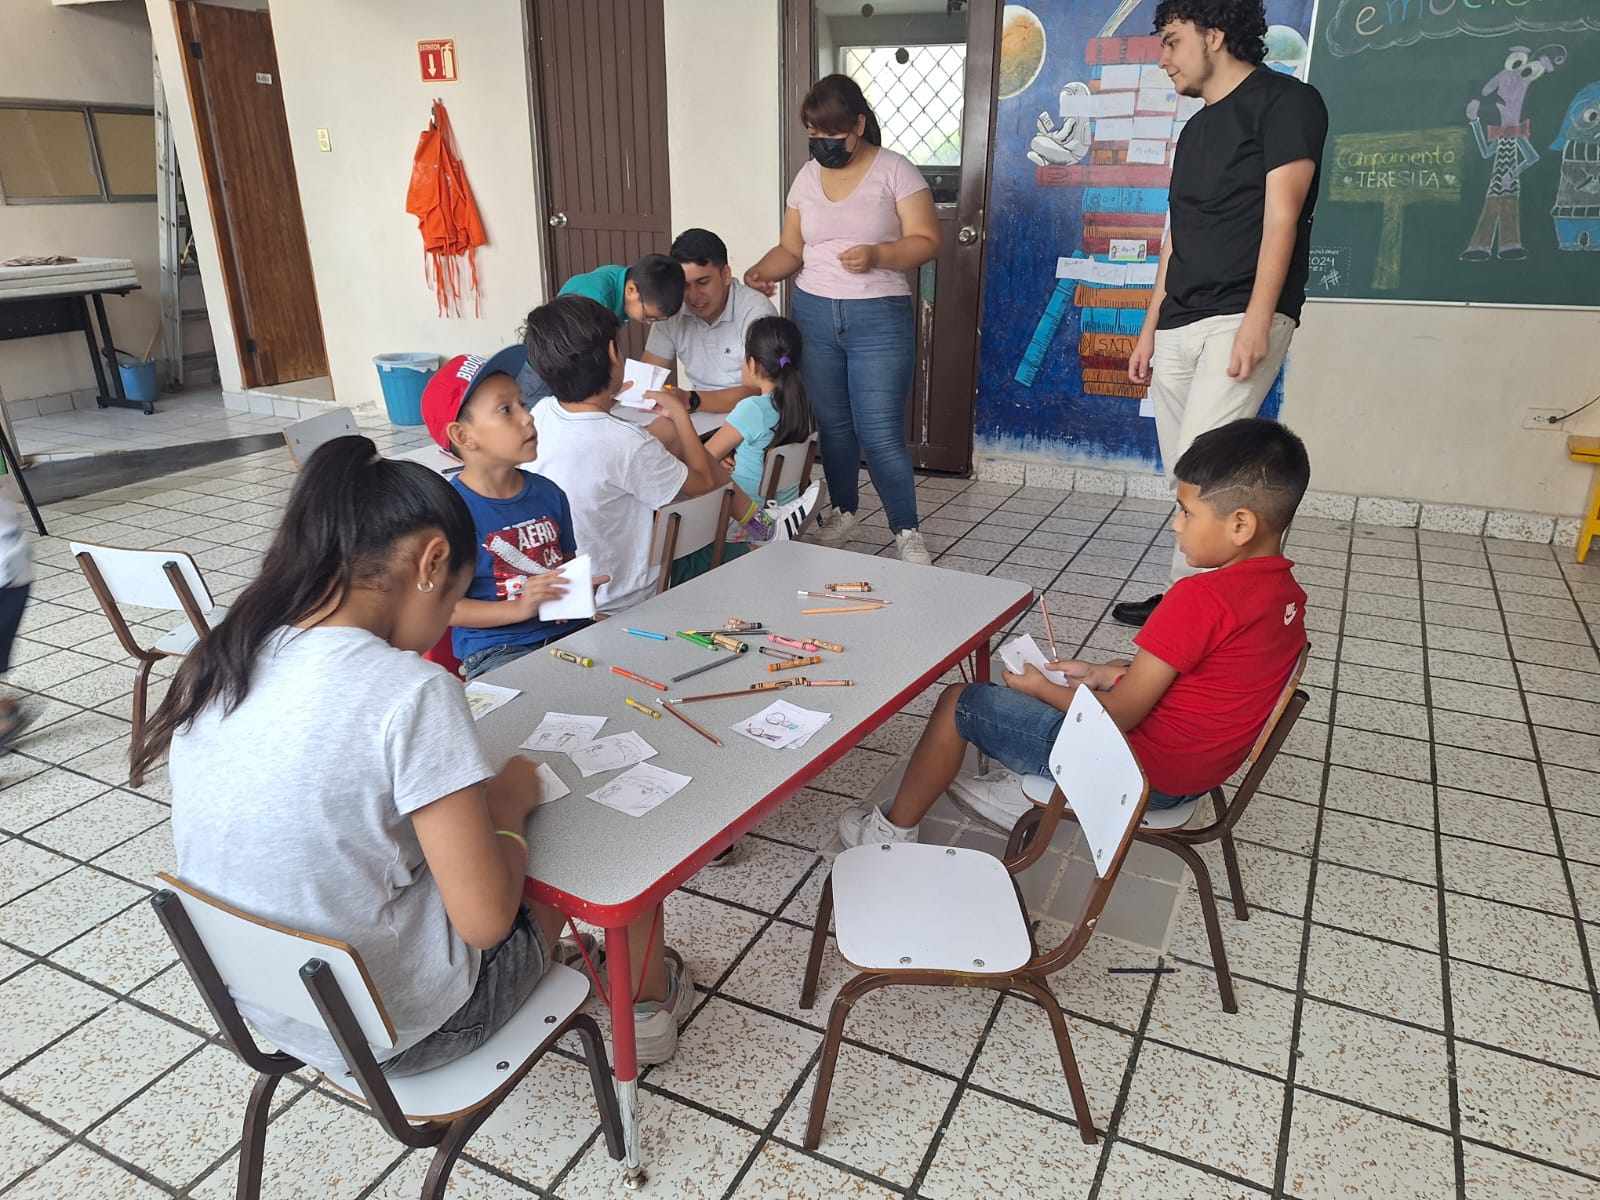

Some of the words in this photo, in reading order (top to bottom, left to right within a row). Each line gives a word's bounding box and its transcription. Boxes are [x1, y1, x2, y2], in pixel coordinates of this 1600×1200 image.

[1355, 170, 1440, 189] TERESITA
[1308, 256, 1335, 267] 024
[518, 520, 557, 551] AERO
